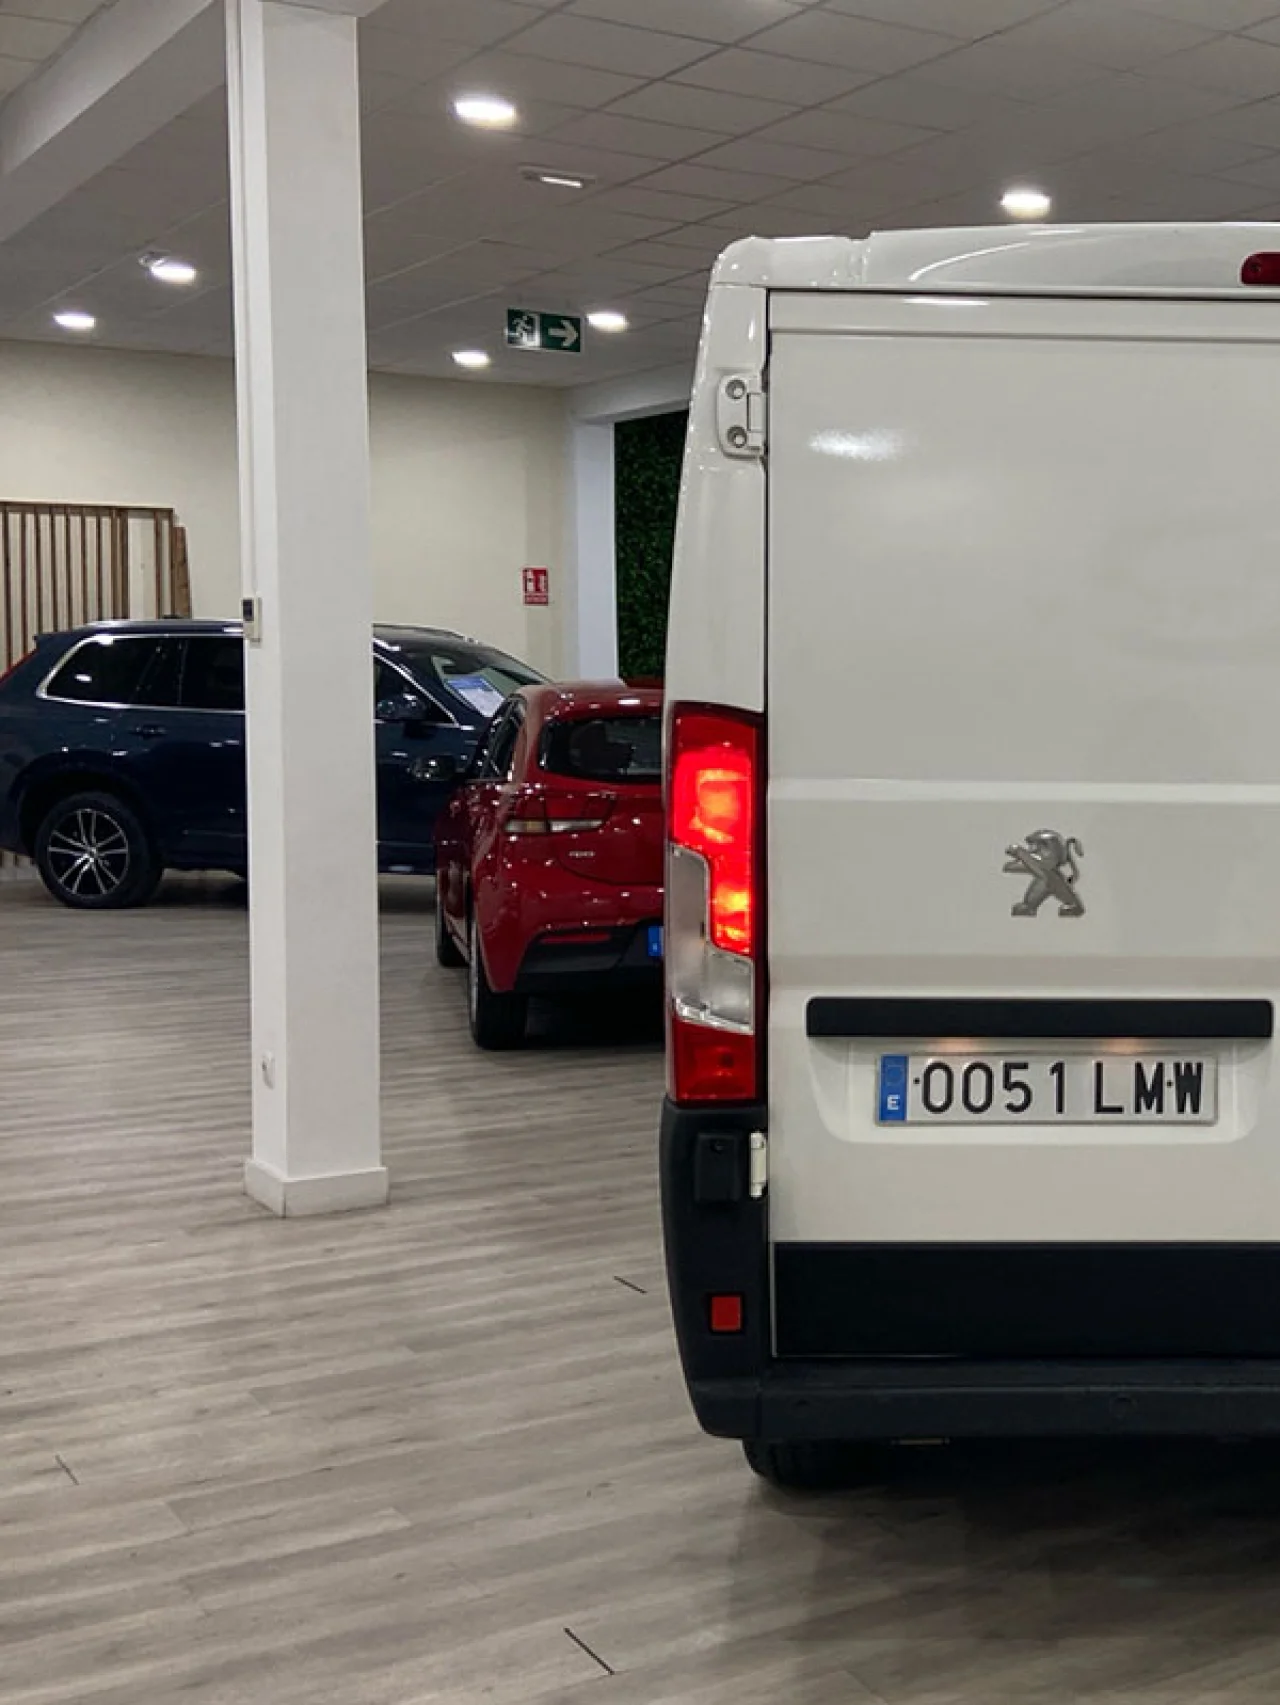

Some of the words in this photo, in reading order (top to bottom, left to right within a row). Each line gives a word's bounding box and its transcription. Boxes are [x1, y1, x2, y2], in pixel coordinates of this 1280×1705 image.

[887, 1094, 899, 1110] E
[921, 1061, 1065, 1114] 0051
[1093, 1060, 1203, 1114] LMW
